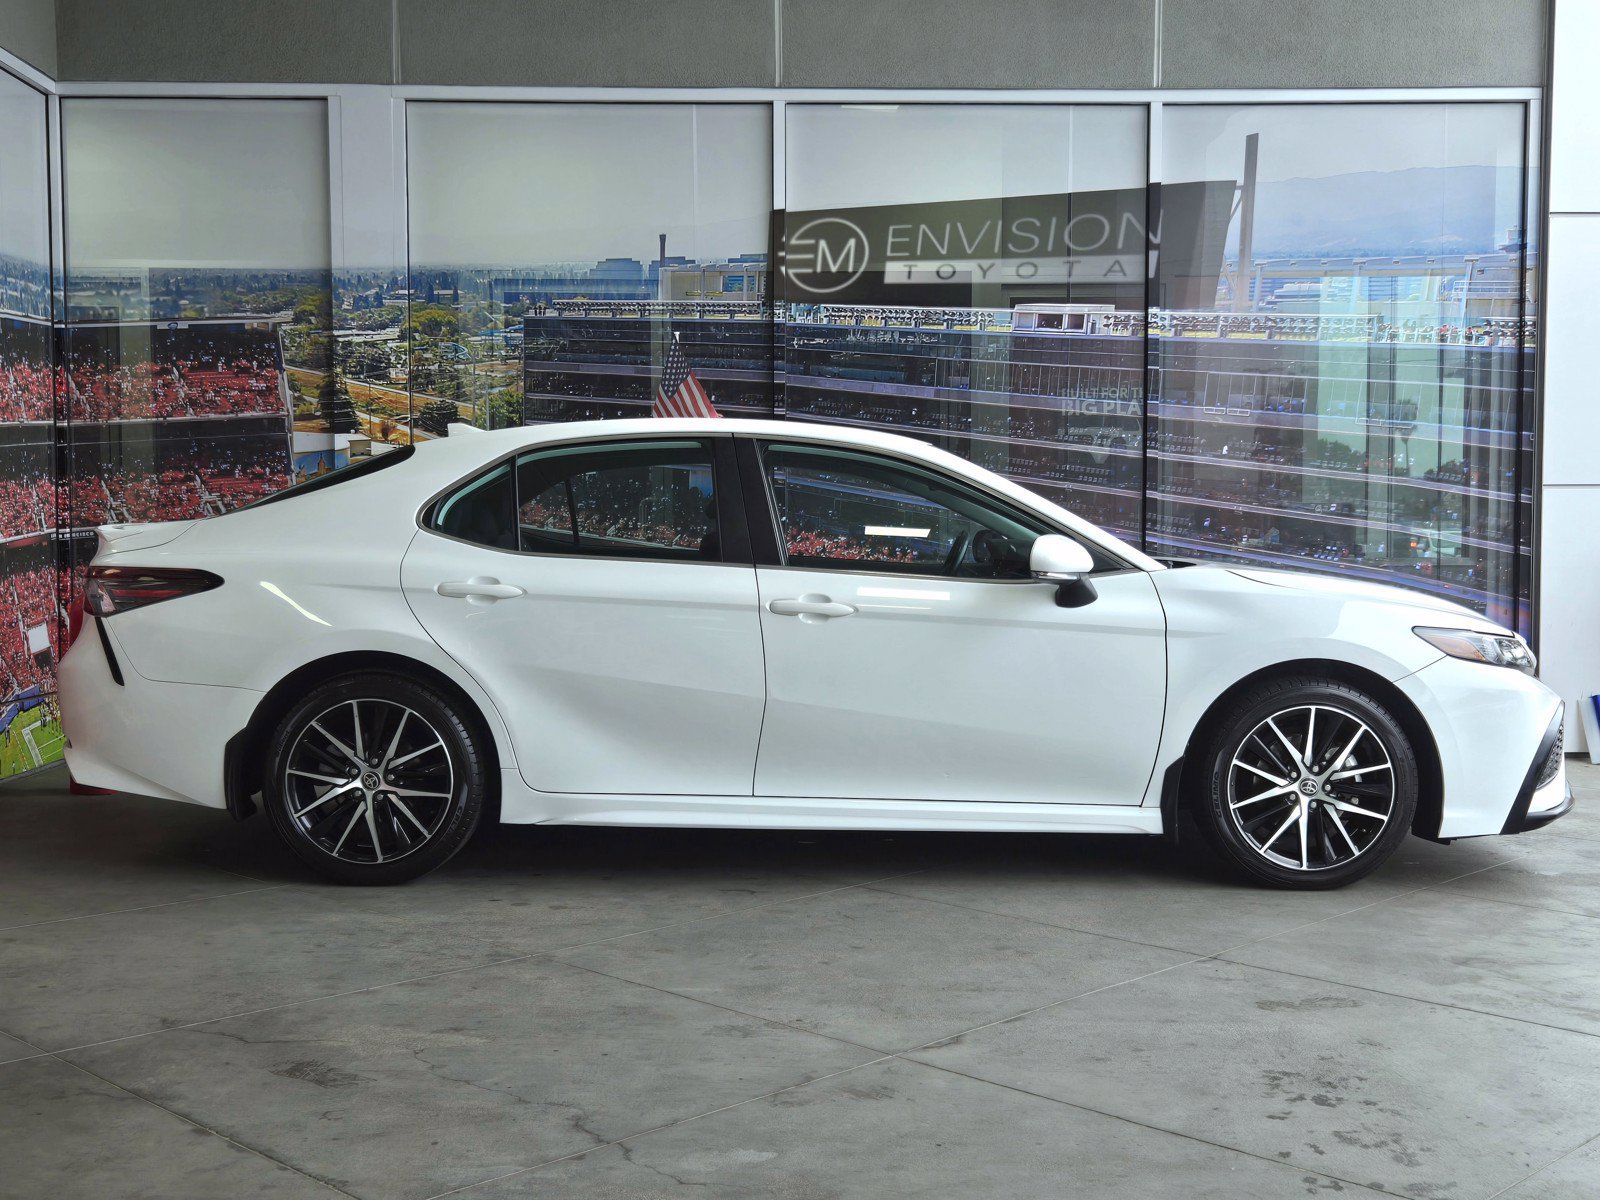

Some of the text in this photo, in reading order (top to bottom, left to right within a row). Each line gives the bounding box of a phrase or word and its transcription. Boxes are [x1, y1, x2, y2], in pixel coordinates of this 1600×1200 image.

[886, 209, 1163, 257] ENVISION
[902, 259, 1128, 281] TOYOTA
[1103, 399, 1144, 416] PLA
